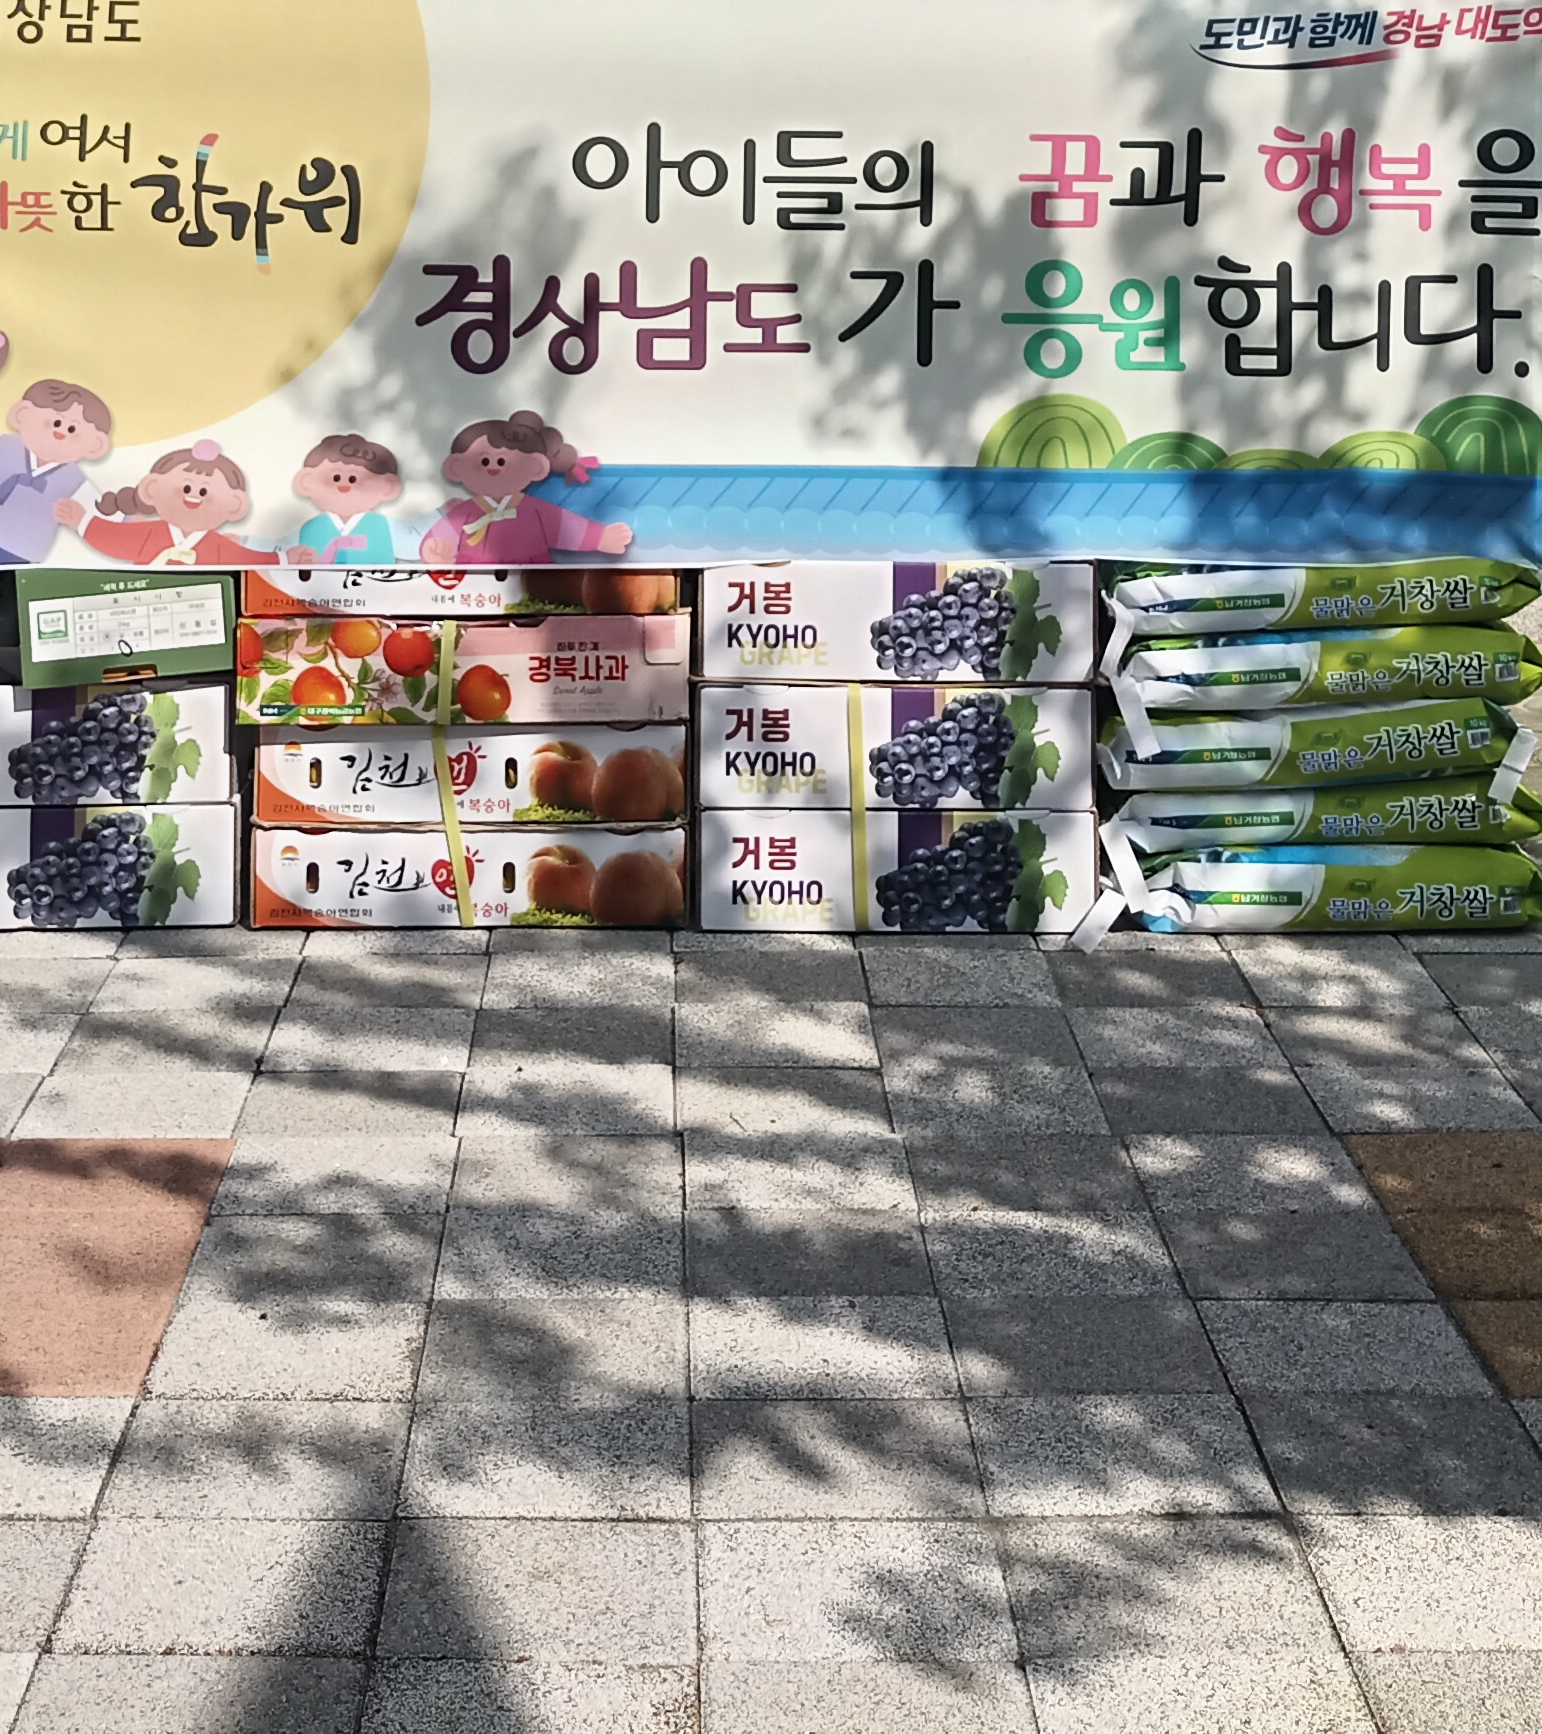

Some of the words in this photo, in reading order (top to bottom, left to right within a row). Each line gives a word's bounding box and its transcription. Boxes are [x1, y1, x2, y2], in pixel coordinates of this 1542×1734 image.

[1198, 13, 1305, 51] 도민과
[1309, 10, 1379, 49] 함께
[1382, 9, 1452, 49] 경남
[571, 121, 934, 231] 아이들의
[1017, 127, 1226, 229] 꿈과
[130, 132, 361, 275] 한가위
[1001, 254, 1530, 379] 응원합니다.
[460, 592, 502, 607] 복숭아
[726, 580, 793, 615] 거봉
[1311, 596, 1377, 618] 물맑은
[1378, 575, 1476, 613] 거창쌀
[726, 623, 818, 649] KYOHO
[739, 641, 828, 666] GRAPE
[528, 654, 629, 683] 경북사과
[1325, 670, 1392, 694] 물맑은
[1392, 651, 1490, 687] 거창쌀
[724, 707, 791, 743] 거봉
[724, 751, 817, 777] KYOHO
[1297, 747, 1364, 773] 물맑은
[1363, 720, 1462, 763] 거창쌀
[737, 768, 828, 795] GRAPE
[469, 797, 512, 813] 복숭아
[1319, 814, 1386, 837] 물맑은
[1386, 794, 1484, 833] 거창쌀
[730, 836, 798, 871] 거봉
[730, 879, 824, 906] KYOHO
[742, 897, 833, 923] GRAPE
[1327, 898, 1395, 921] 물맑은
[1395, 882, 1494, 919] 거창쌀
